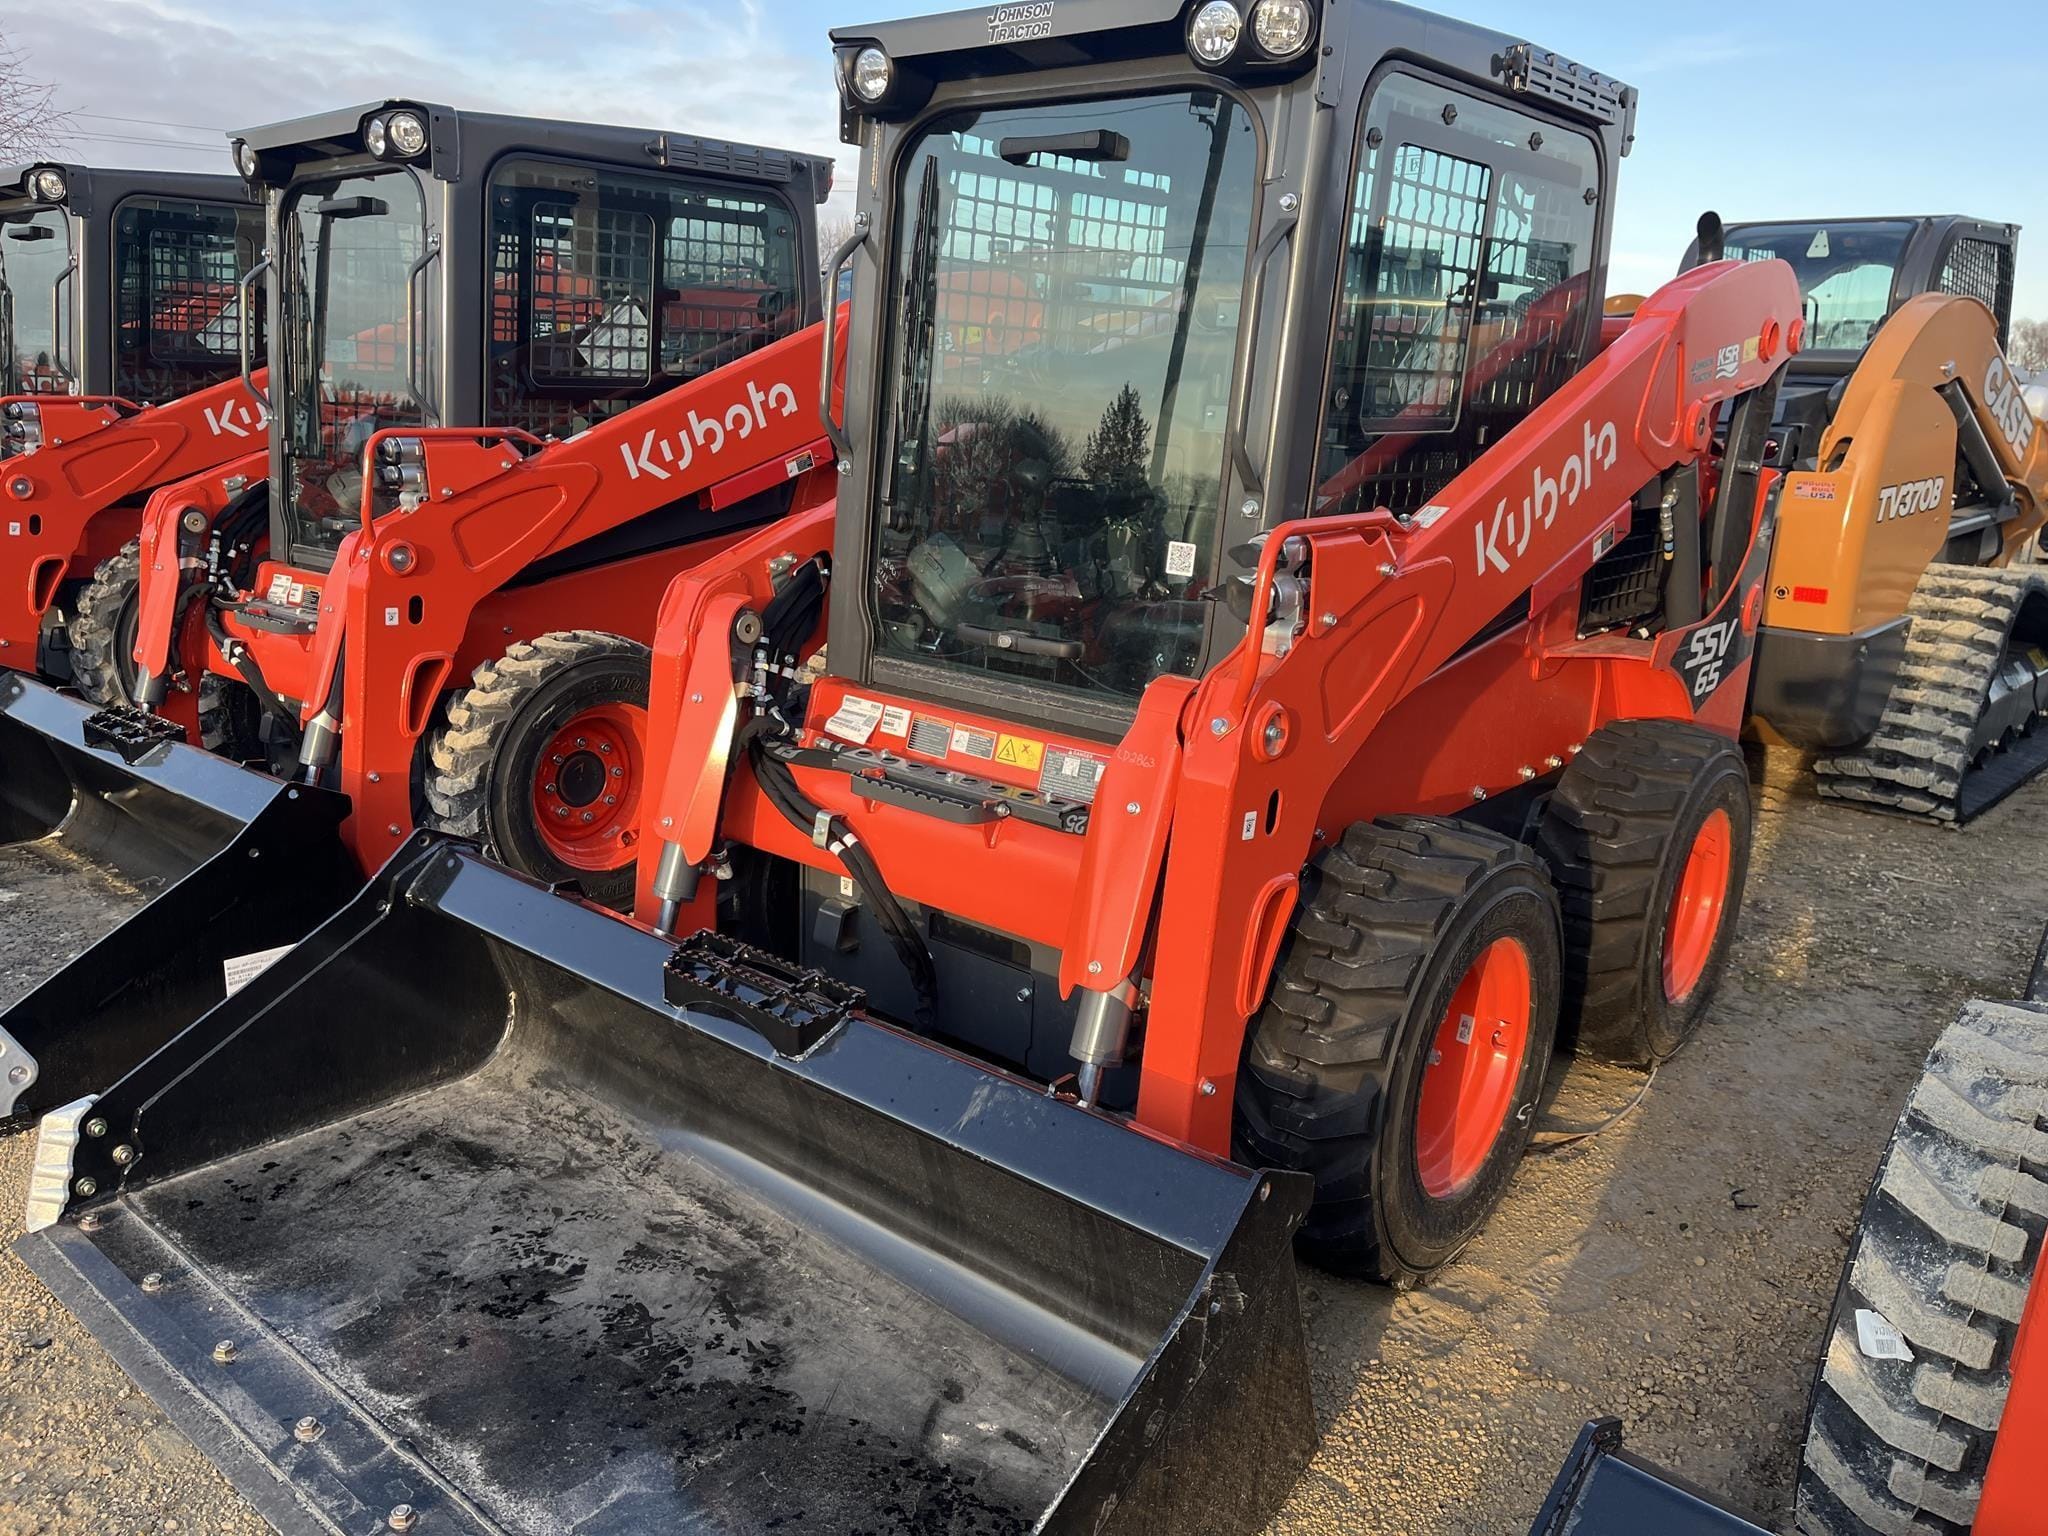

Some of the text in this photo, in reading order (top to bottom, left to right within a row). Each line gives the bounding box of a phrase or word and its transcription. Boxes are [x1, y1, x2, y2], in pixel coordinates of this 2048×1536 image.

[987, 1, 1054, 24] JOHNSON
[988, 21, 1051, 43] TRACTOR
[1717, 343, 1740, 366] KSR
[619, 380, 799, 480] Kubota
[1983, 355, 2034, 464] CASE
[1475, 419, 1617, 576] Kubota
[1810, 491, 1834, 499] USA
[1876, 476, 1944, 523] TV370B
[1685, 618, 1739, 669] SSV
[1694, 659, 1723, 697] 65
